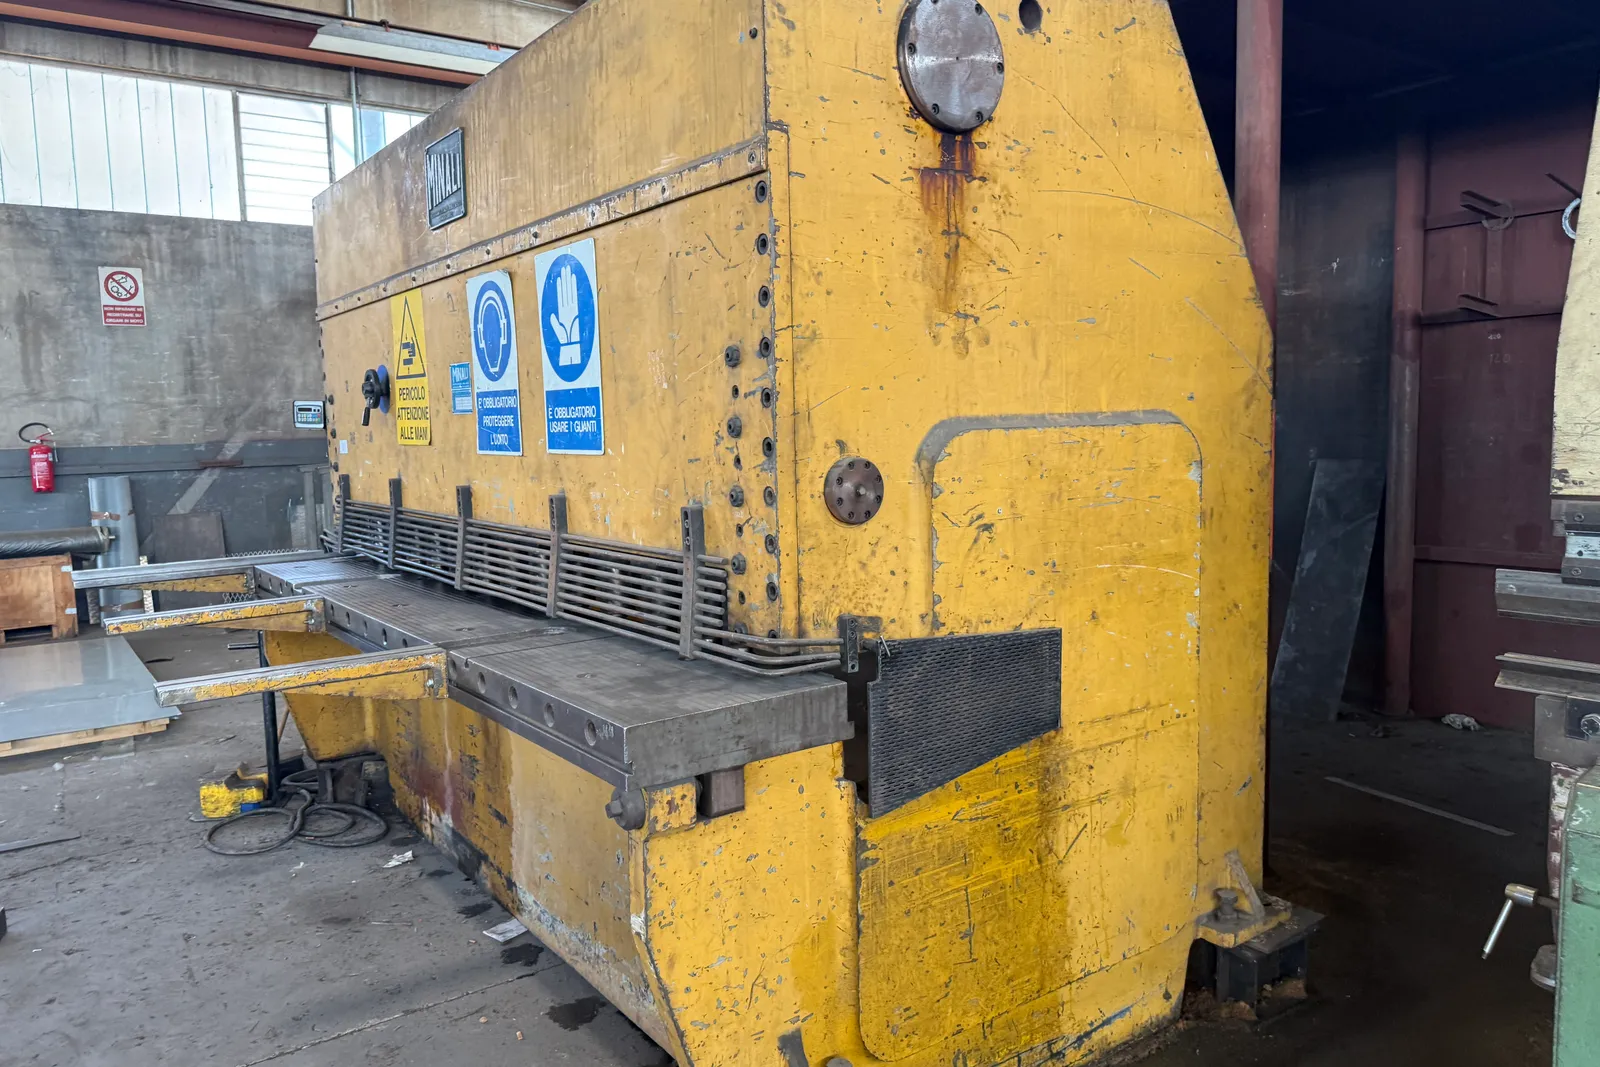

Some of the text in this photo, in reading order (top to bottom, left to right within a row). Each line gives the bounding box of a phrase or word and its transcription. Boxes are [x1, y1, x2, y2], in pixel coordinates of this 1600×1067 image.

[426, 153, 461, 211] MINALI
[398, 386, 426, 401] PERICOLO
[482, 395, 517, 409] OBBLIGATORIO
[397, 406, 429, 421] ATTENZIONE
[554, 405, 597, 419] OBBLIGATORIO
[483, 415, 515, 427] PROTEGGERE
[549, 421, 569, 433] USARE
[573, 420, 597, 433] GUANTI
[400, 426, 428, 440] ALLE MANI
